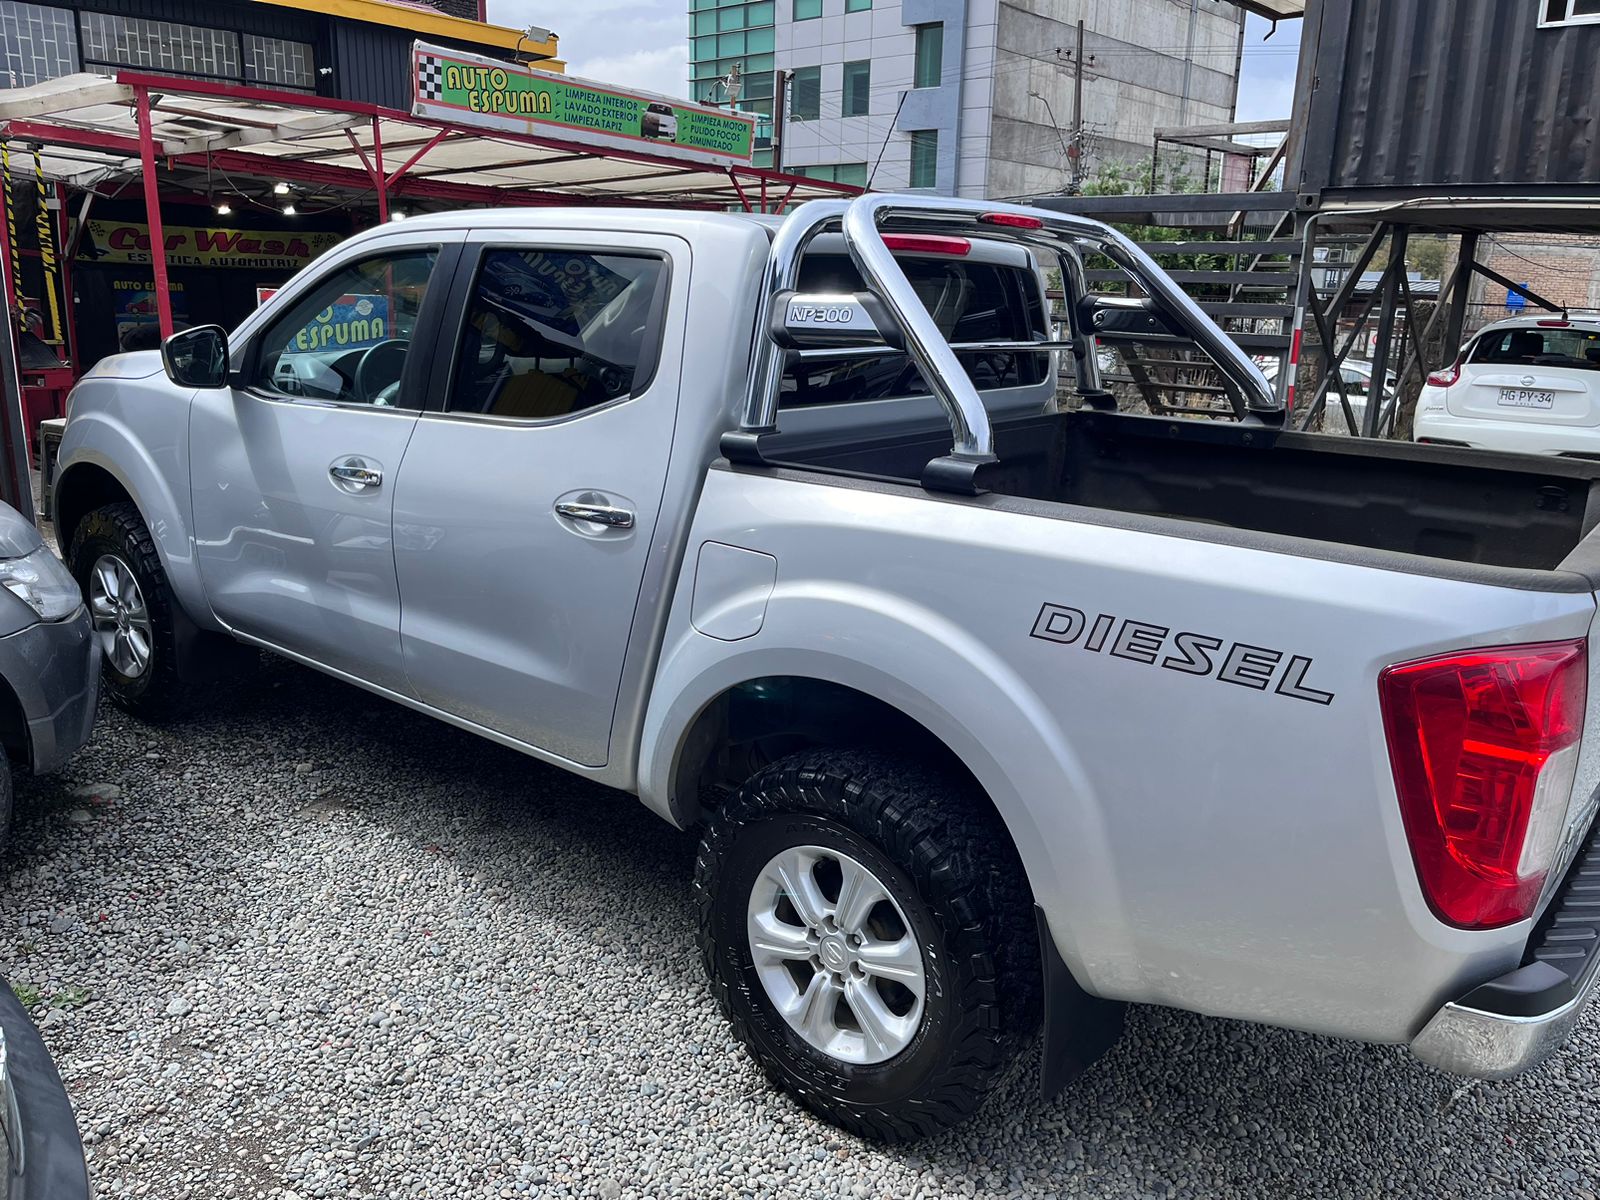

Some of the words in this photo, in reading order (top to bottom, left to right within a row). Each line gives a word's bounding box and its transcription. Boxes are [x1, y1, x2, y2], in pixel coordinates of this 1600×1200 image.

[446, 65, 508, 91] AUTO
[468, 90, 552, 113] ESPUMA
[565, 88, 601, 104] LIMPIEZA
[603, 96, 638, 111] INTERIOR
[564, 101, 600, 115] LAVADO
[602, 108, 638, 122] EXTERIOR
[564, 113, 600, 128] LIMPIEZA
[601, 120, 622, 131] TAPIZ
[691, 114, 721, 127] LIMPIEZA
[722, 120, 747, 132] MOTOR
[690, 125, 715, 137] PULIDO
[716, 130, 740, 142] FOCOS
[690, 135, 733, 151] SIMUNIZADO
[109, 227, 187, 250] Car
[195, 231, 310, 257] Wash
[128, 253, 201, 265] ESTICA
[209, 257, 298, 267] AUTOMOTRIZ
[113, 280, 142, 290] AUTO
[145, 281, 184, 292] ESMA
[790, 306, 853, 323] NP300
[295, 317, 384, 351] ESPUMA
[1029, 602, 1335, 706] DIESEL
